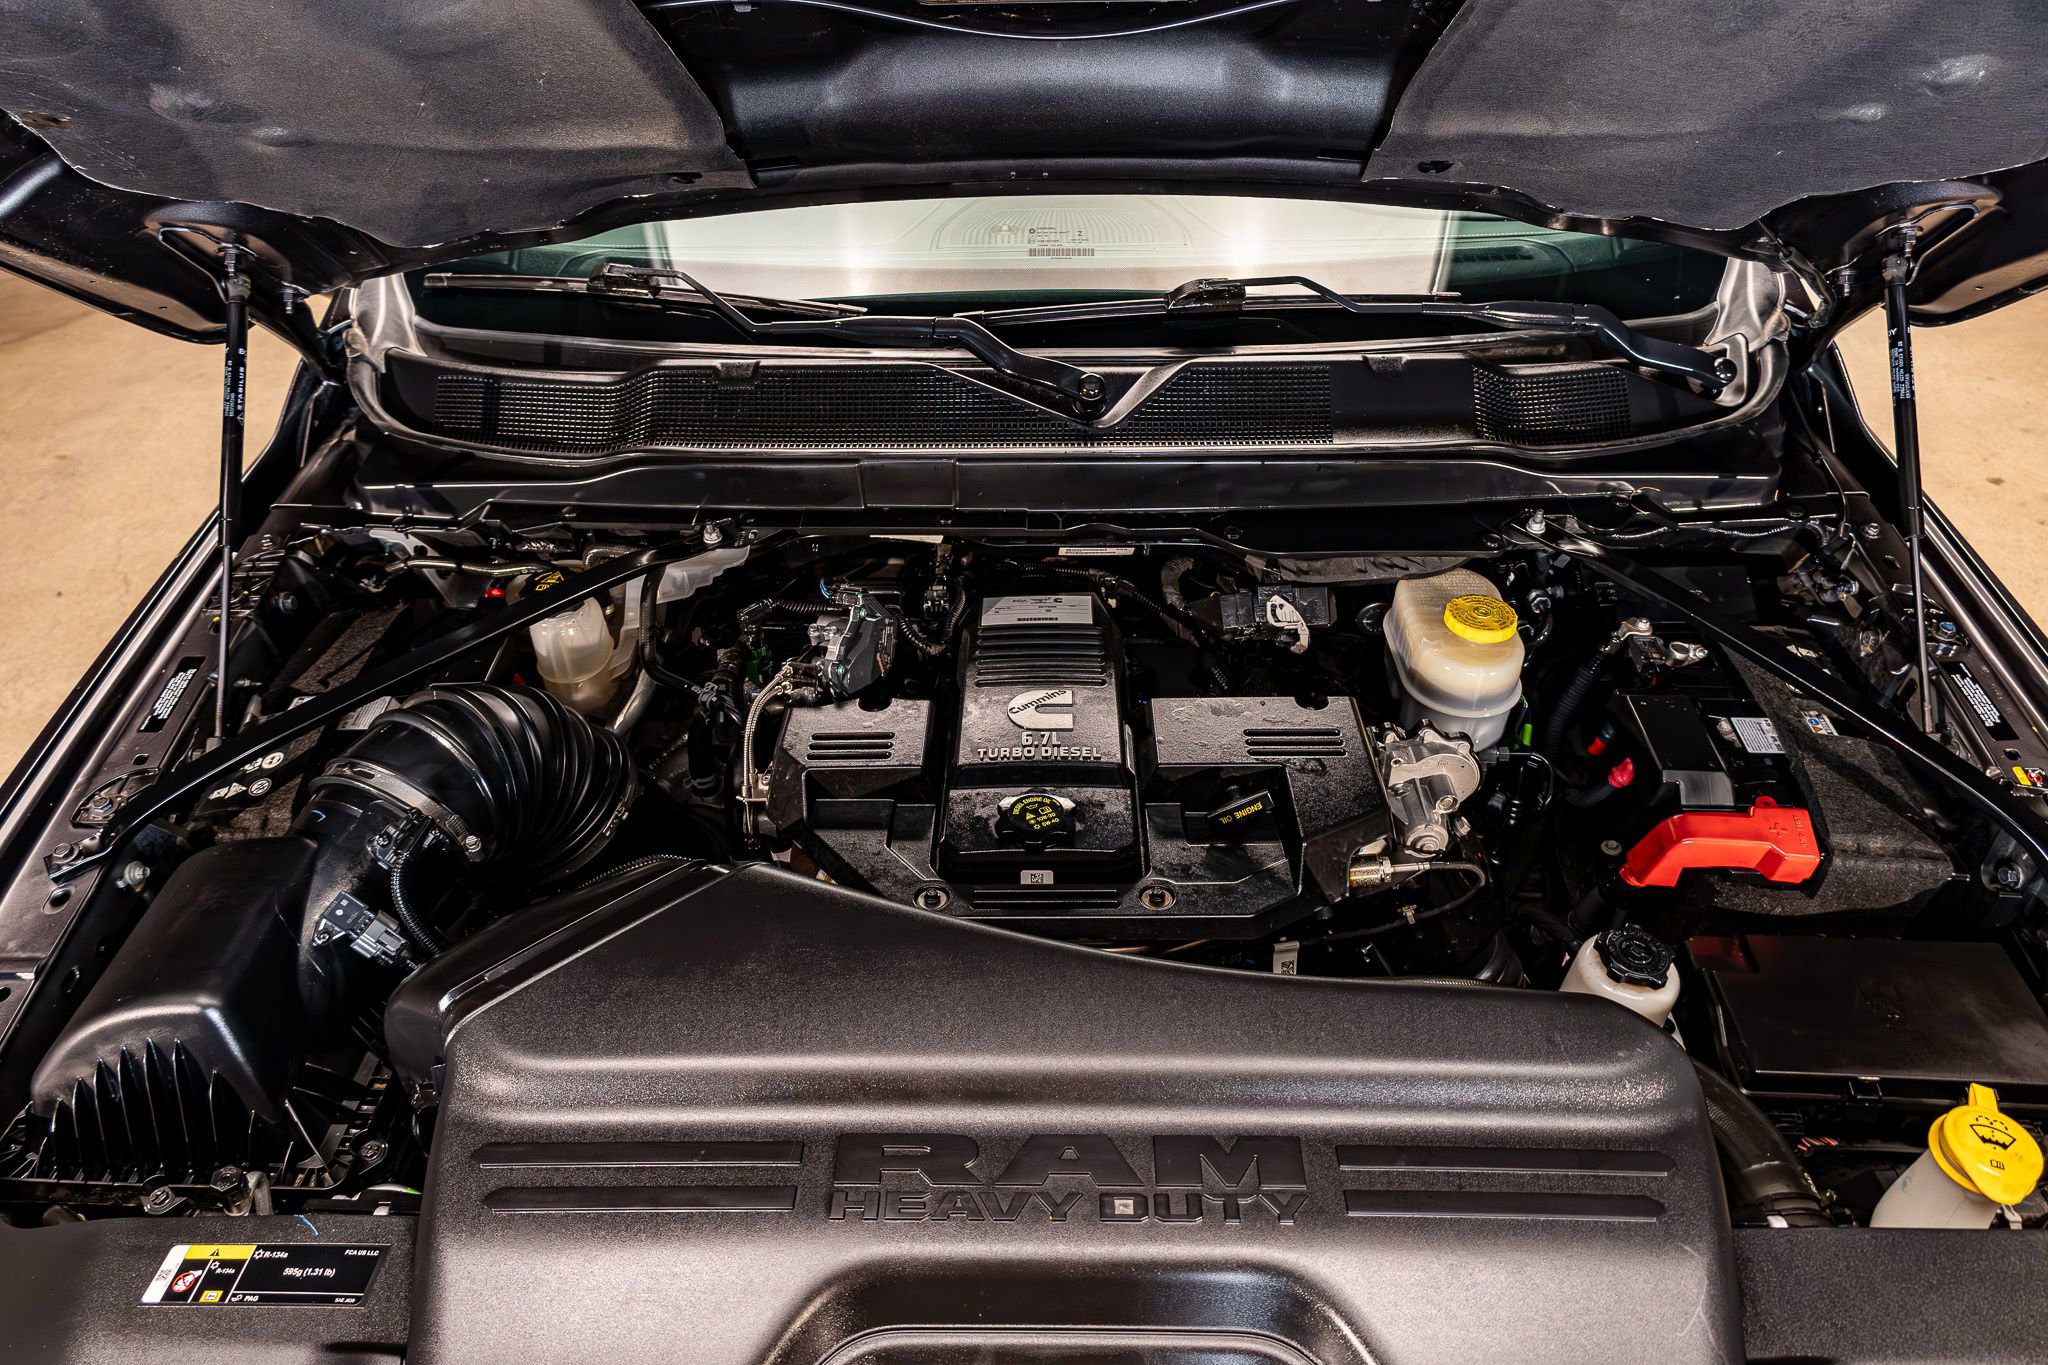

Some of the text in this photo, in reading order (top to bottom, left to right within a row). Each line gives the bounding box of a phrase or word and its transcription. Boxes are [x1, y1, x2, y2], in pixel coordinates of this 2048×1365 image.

[1008, 689, 1067, 714] Cummins
[1021, 731, 1061, 747] 6.7L
[978, 746, 1102, 760] TURBO DIESEL
[1218, 801, 1263, 825] ENGINE OIL
[832, 1133, 1307, 1190] RAM
[828, 1190, 1309, 1226] HEAVY DUTY
[263, 1251, 289, 1259] R-134a
[282, 1267, 336, 1278] 595g (1.31 lb)
